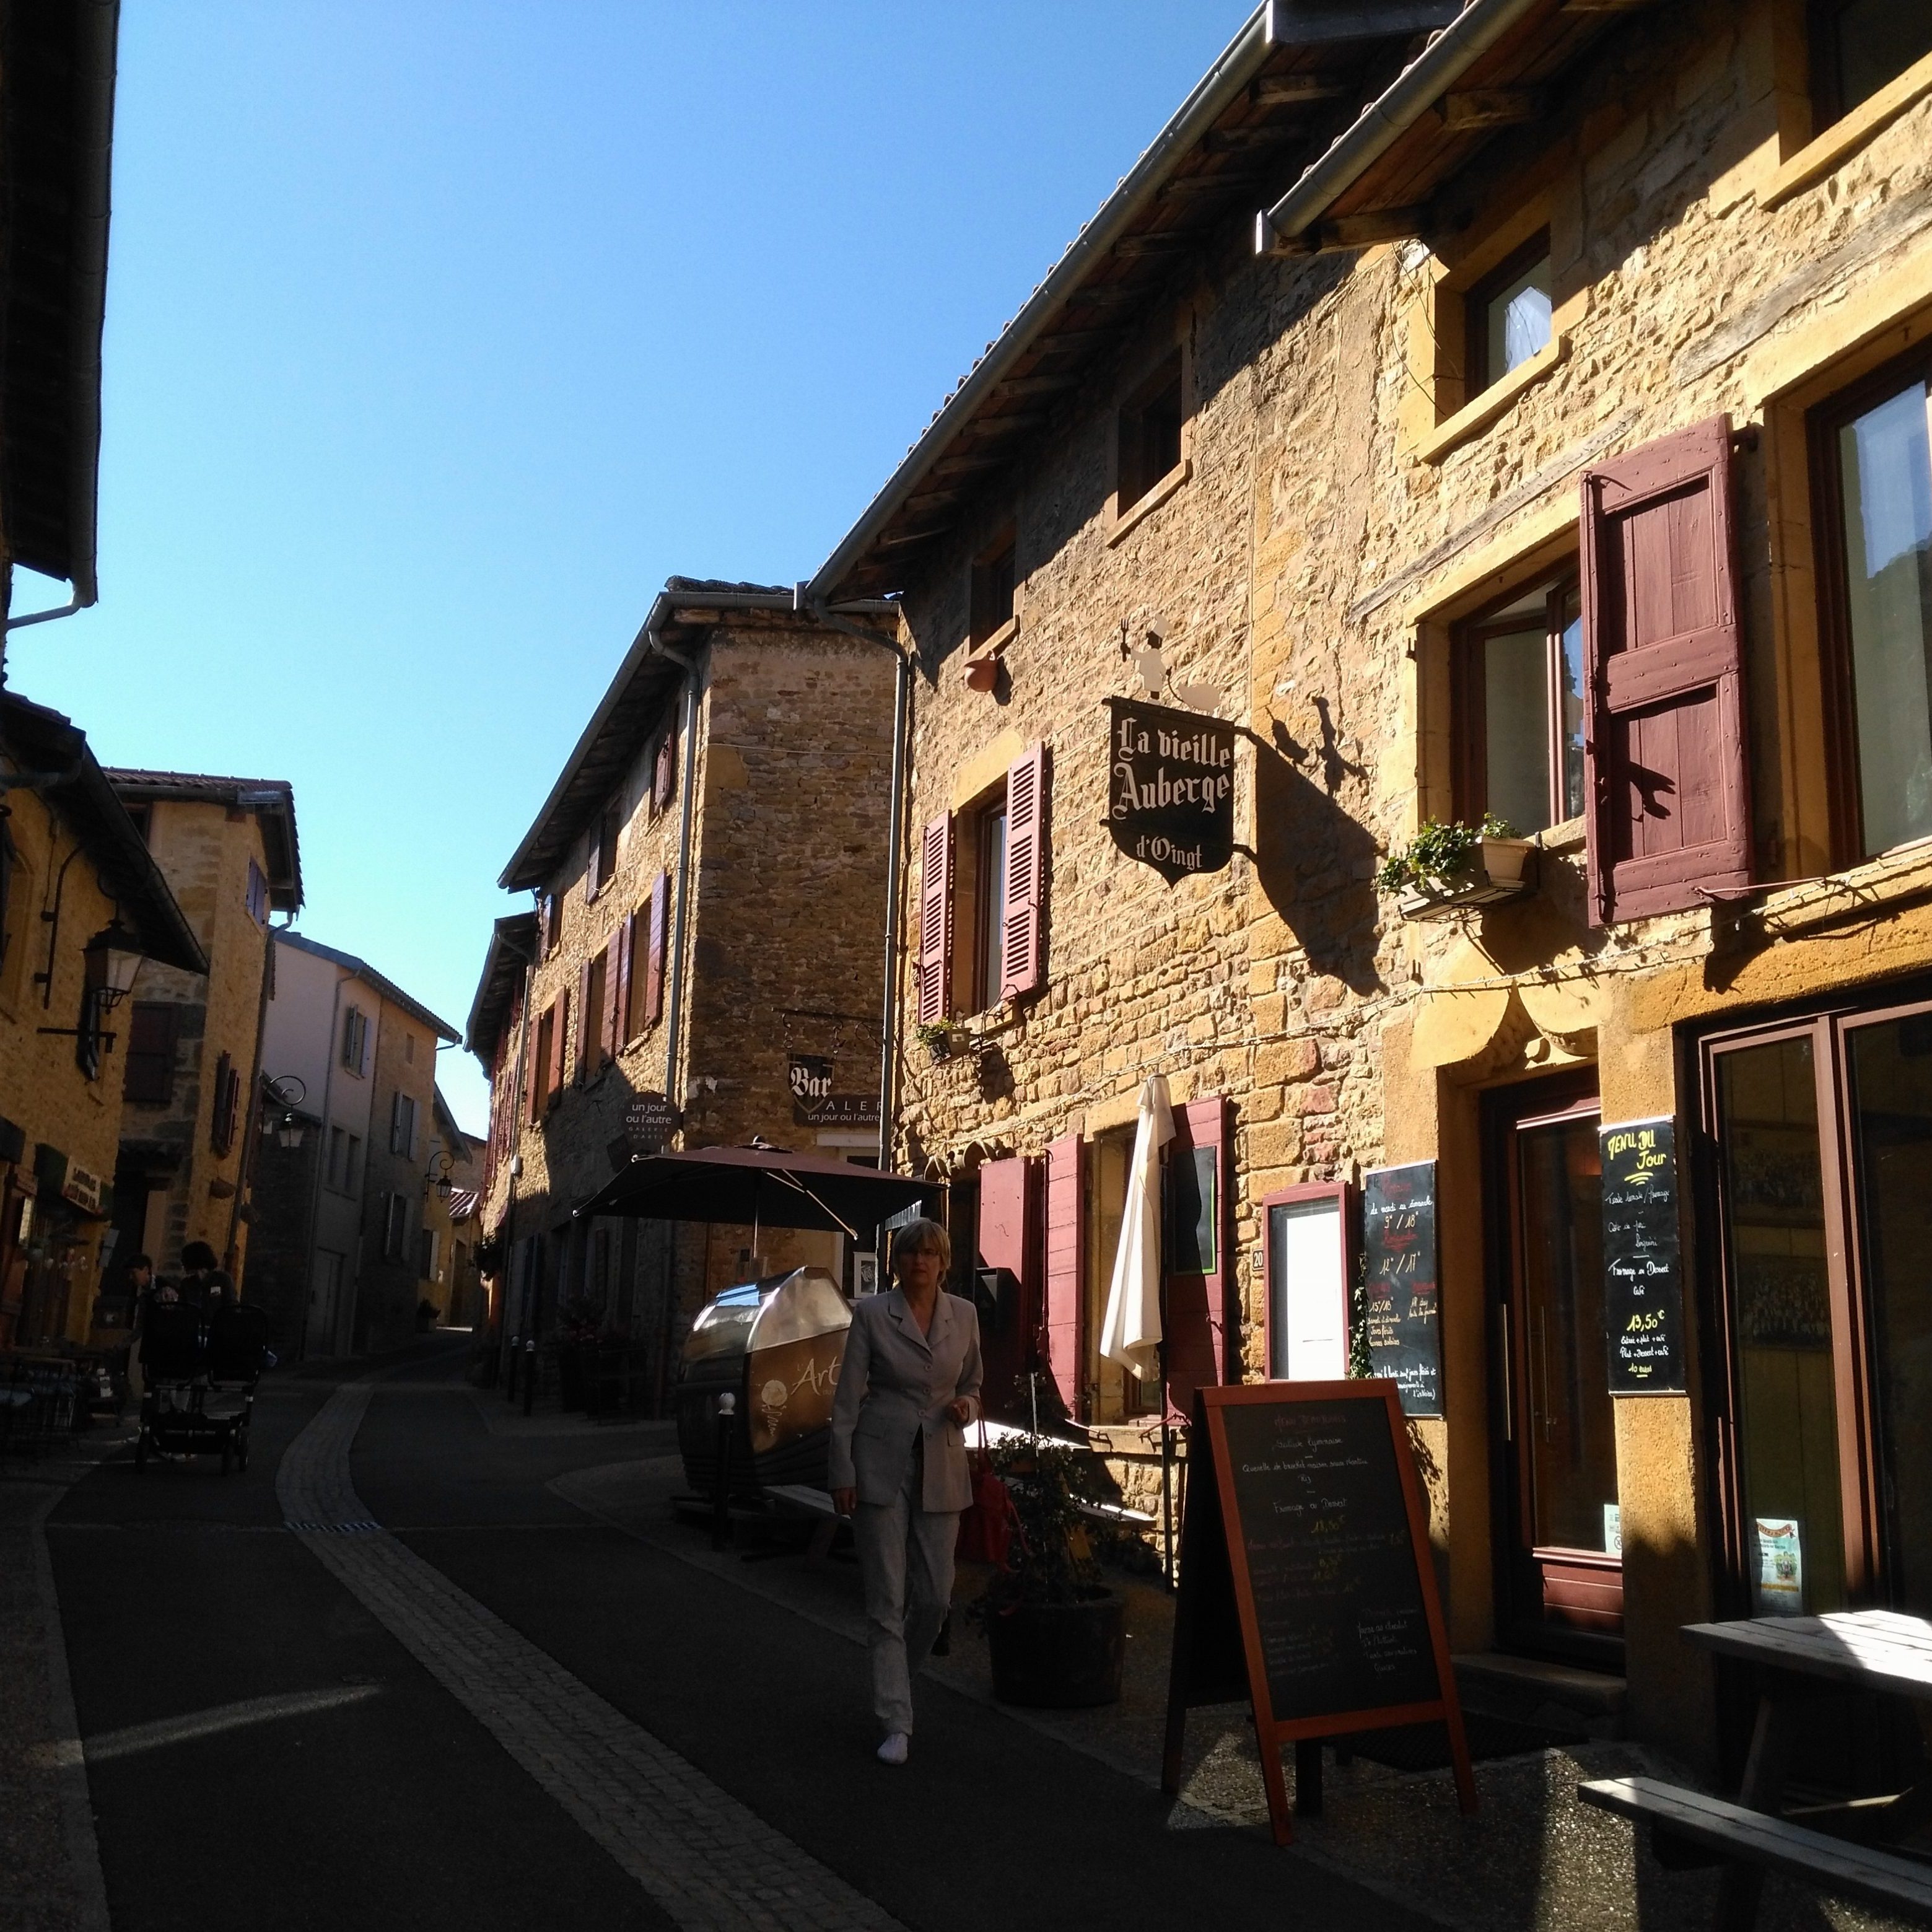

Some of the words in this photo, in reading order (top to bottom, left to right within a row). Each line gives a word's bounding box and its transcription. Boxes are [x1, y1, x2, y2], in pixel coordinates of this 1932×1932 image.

[1117, 717, 1151, 762] La
[1157, 728, 1231, 769] vieille
[1111, 762, 1231, 820] Auberge
[1136, 834, 1203, 871] d'Oingt
[790, 1067, 833, 1098] Bar
[631, 1103, 645, 1112] un
[645, 1103, 667, 1114] jour
[825, 1100, 881, 1111] ALER
[625, 1115, 639, 1124] ou
[641, 1114, 672, 1124] l'autre
[820, 1113, 838, 1123] jour
[853, 1113, 880, 1122] l'autre
[1638, 1129, 1656, 1150] DU
[1637, 1150, 1667, 1169] Jour
[1254, 1252, 1263, 1267] 20
